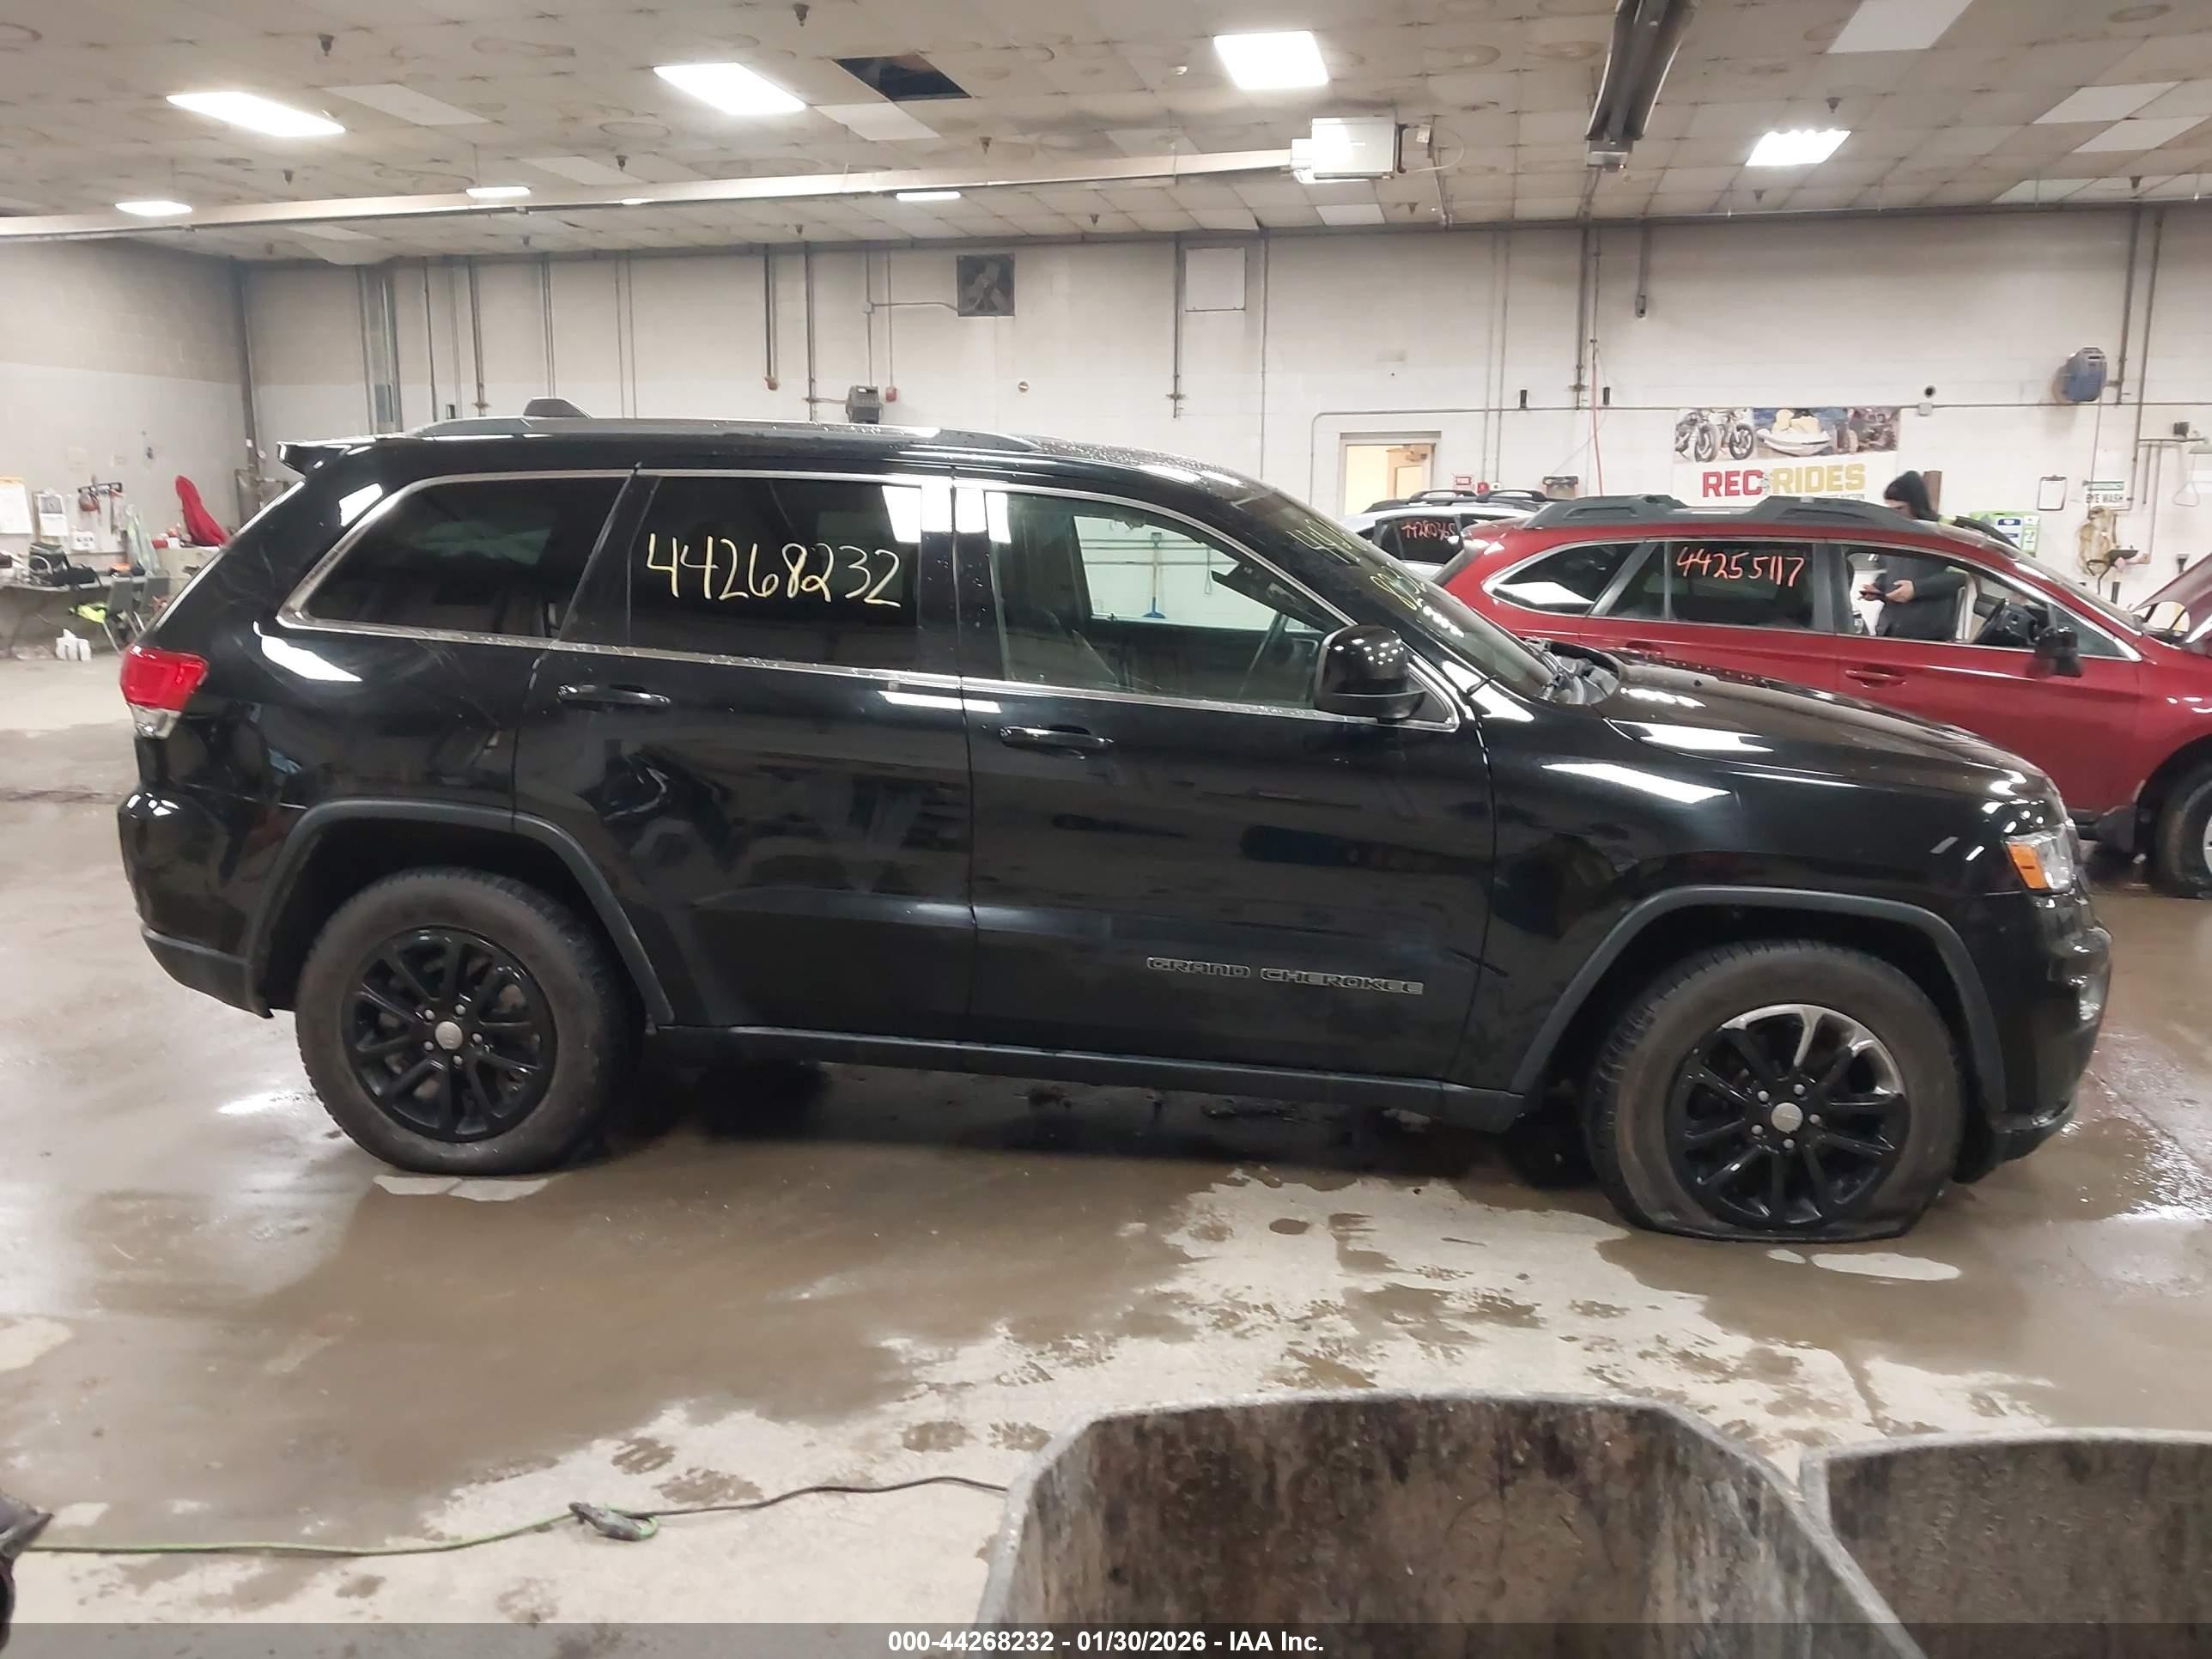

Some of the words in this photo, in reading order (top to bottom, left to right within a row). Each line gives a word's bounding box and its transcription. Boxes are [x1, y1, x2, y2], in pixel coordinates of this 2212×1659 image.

[1702, 469, 1765, 497] REC
[1771, 463, 1865, 494] RIDES
[646, 532, 902, 608] 44268232
[1676, 546, 1804, 587] 44255117
[1146, 957, 1251, 978] GRAND
[1260, 968, 1424, 995] CHEROKEE
